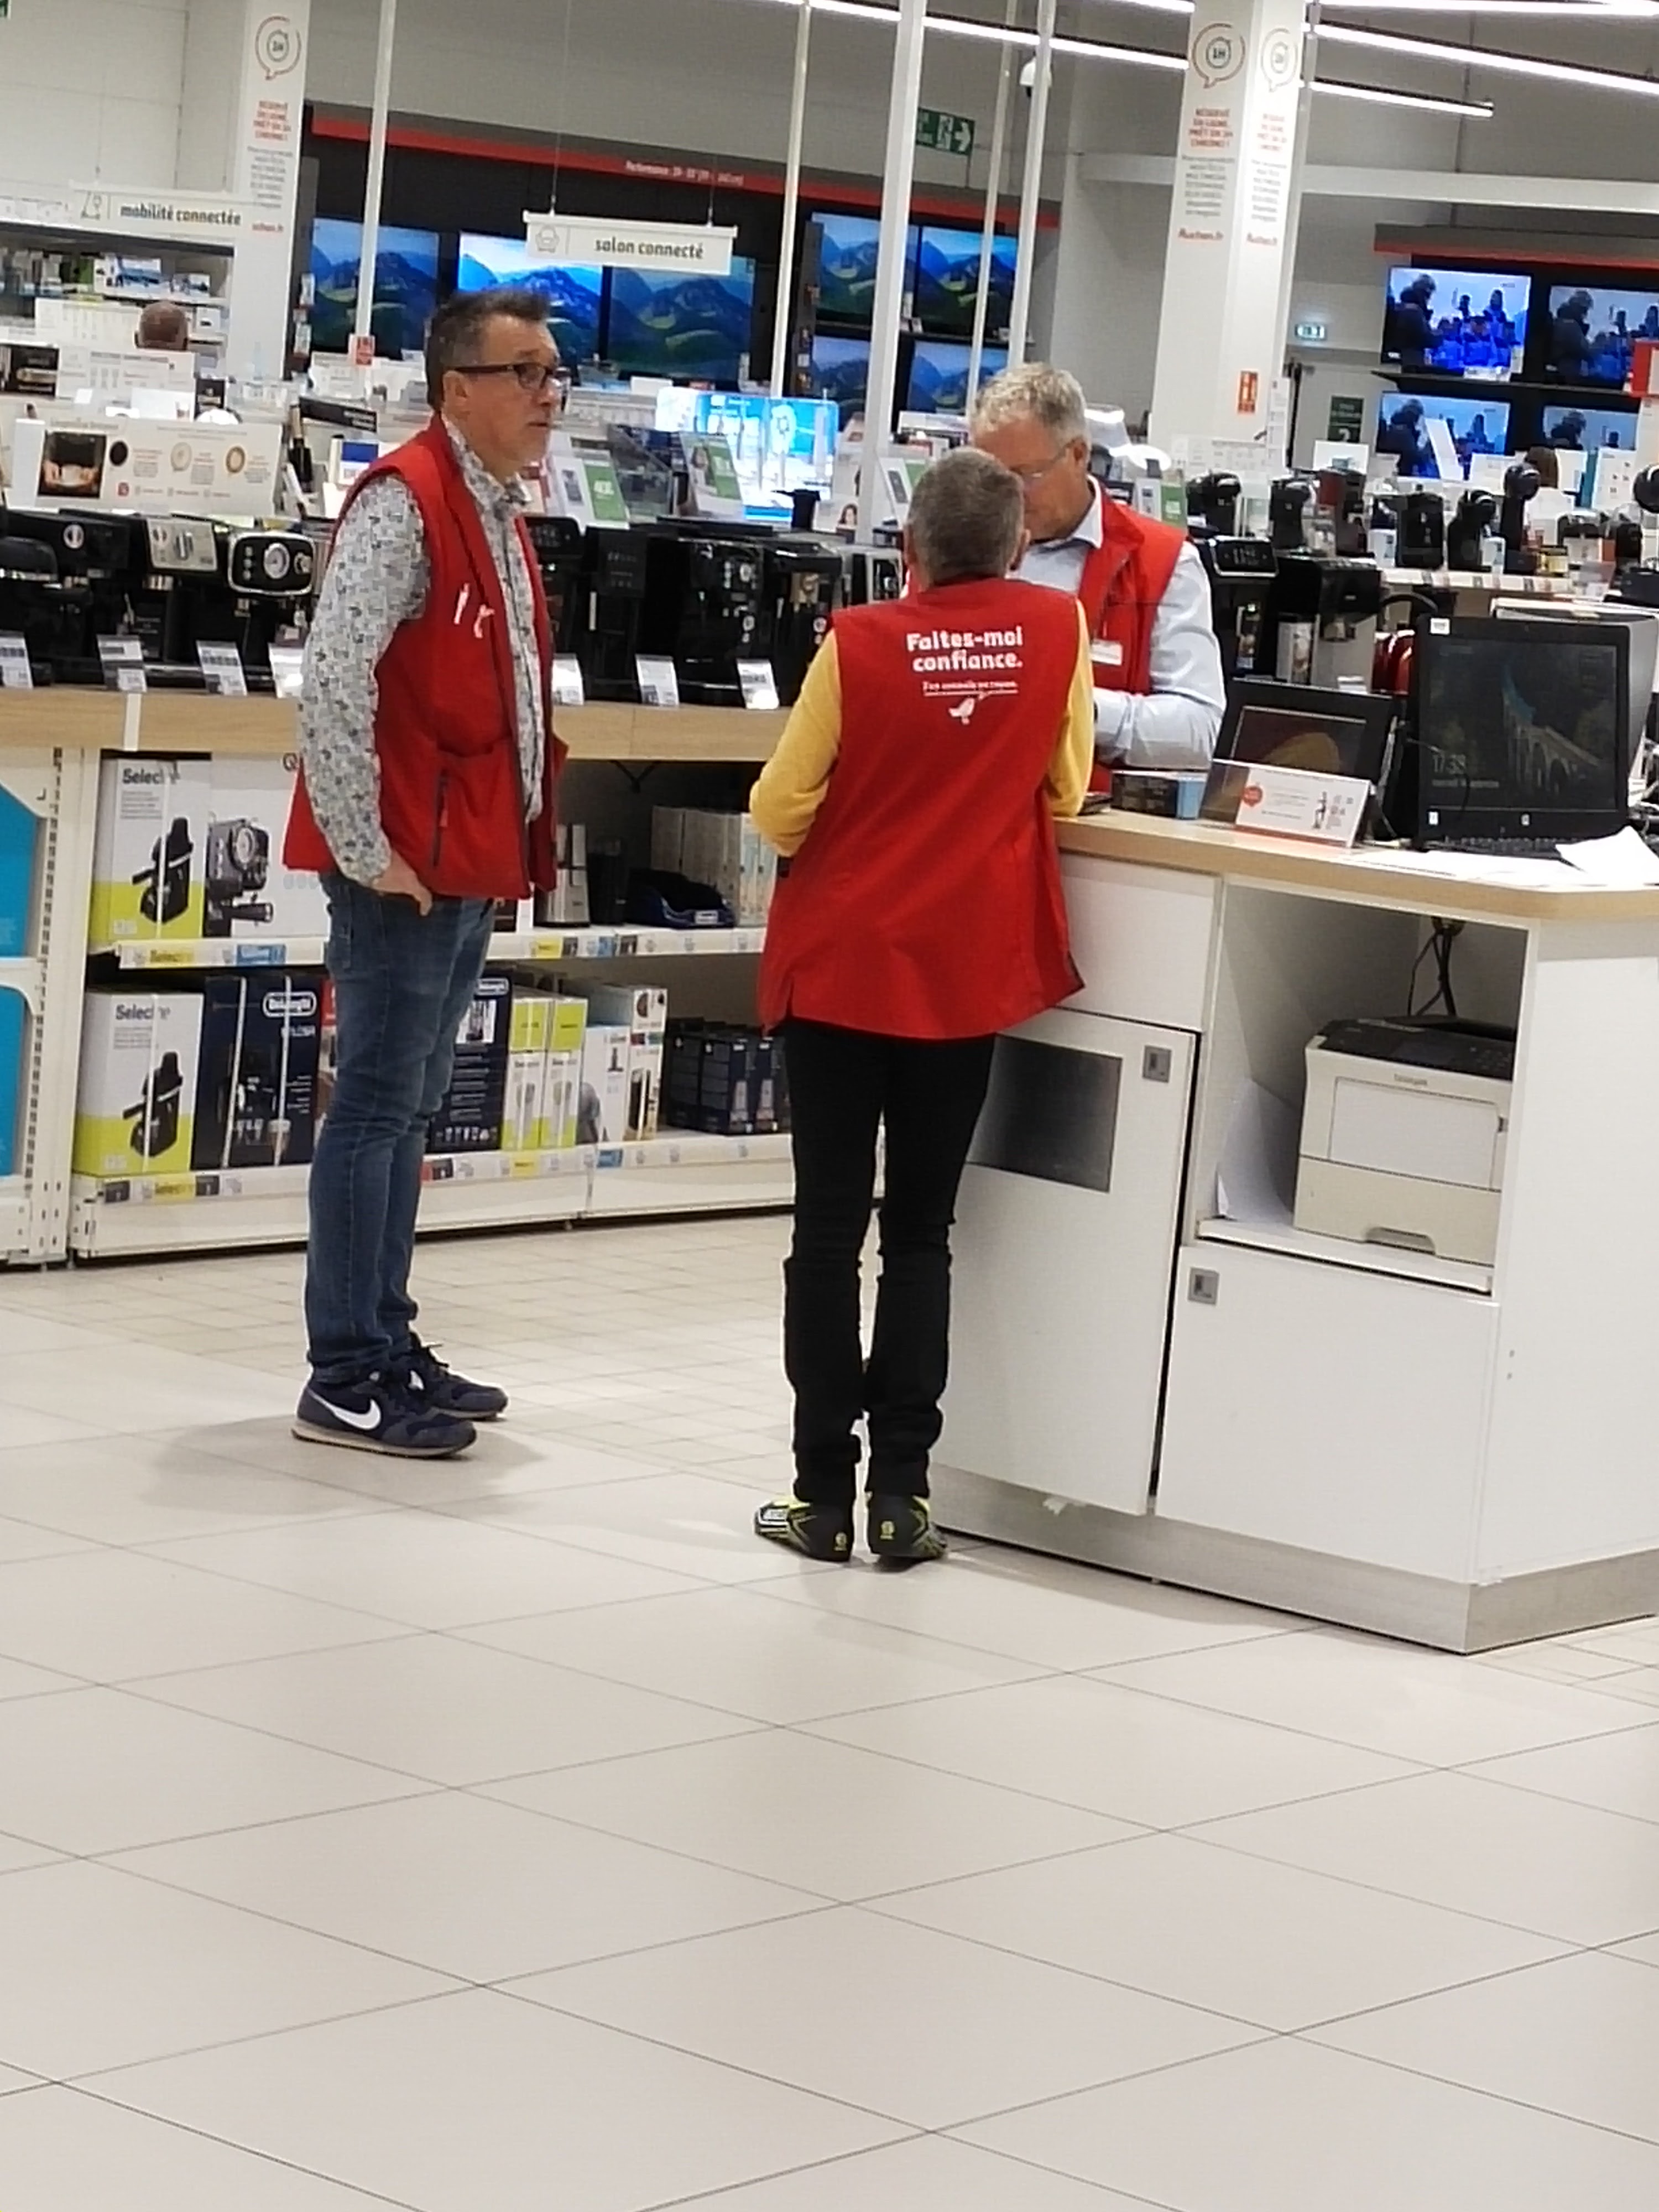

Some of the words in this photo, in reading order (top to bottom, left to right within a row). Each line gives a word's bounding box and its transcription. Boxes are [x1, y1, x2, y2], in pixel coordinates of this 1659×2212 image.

[121, 202, 174, 221] mobilité
[176, 209, 241, 226] connectée
[595, 236, 635, 253] salon
[638, 242, 703, 259] connecté
[906, 625, 1023, 652] Faites-moi
[912, 649, 1023, 671] confiance.
